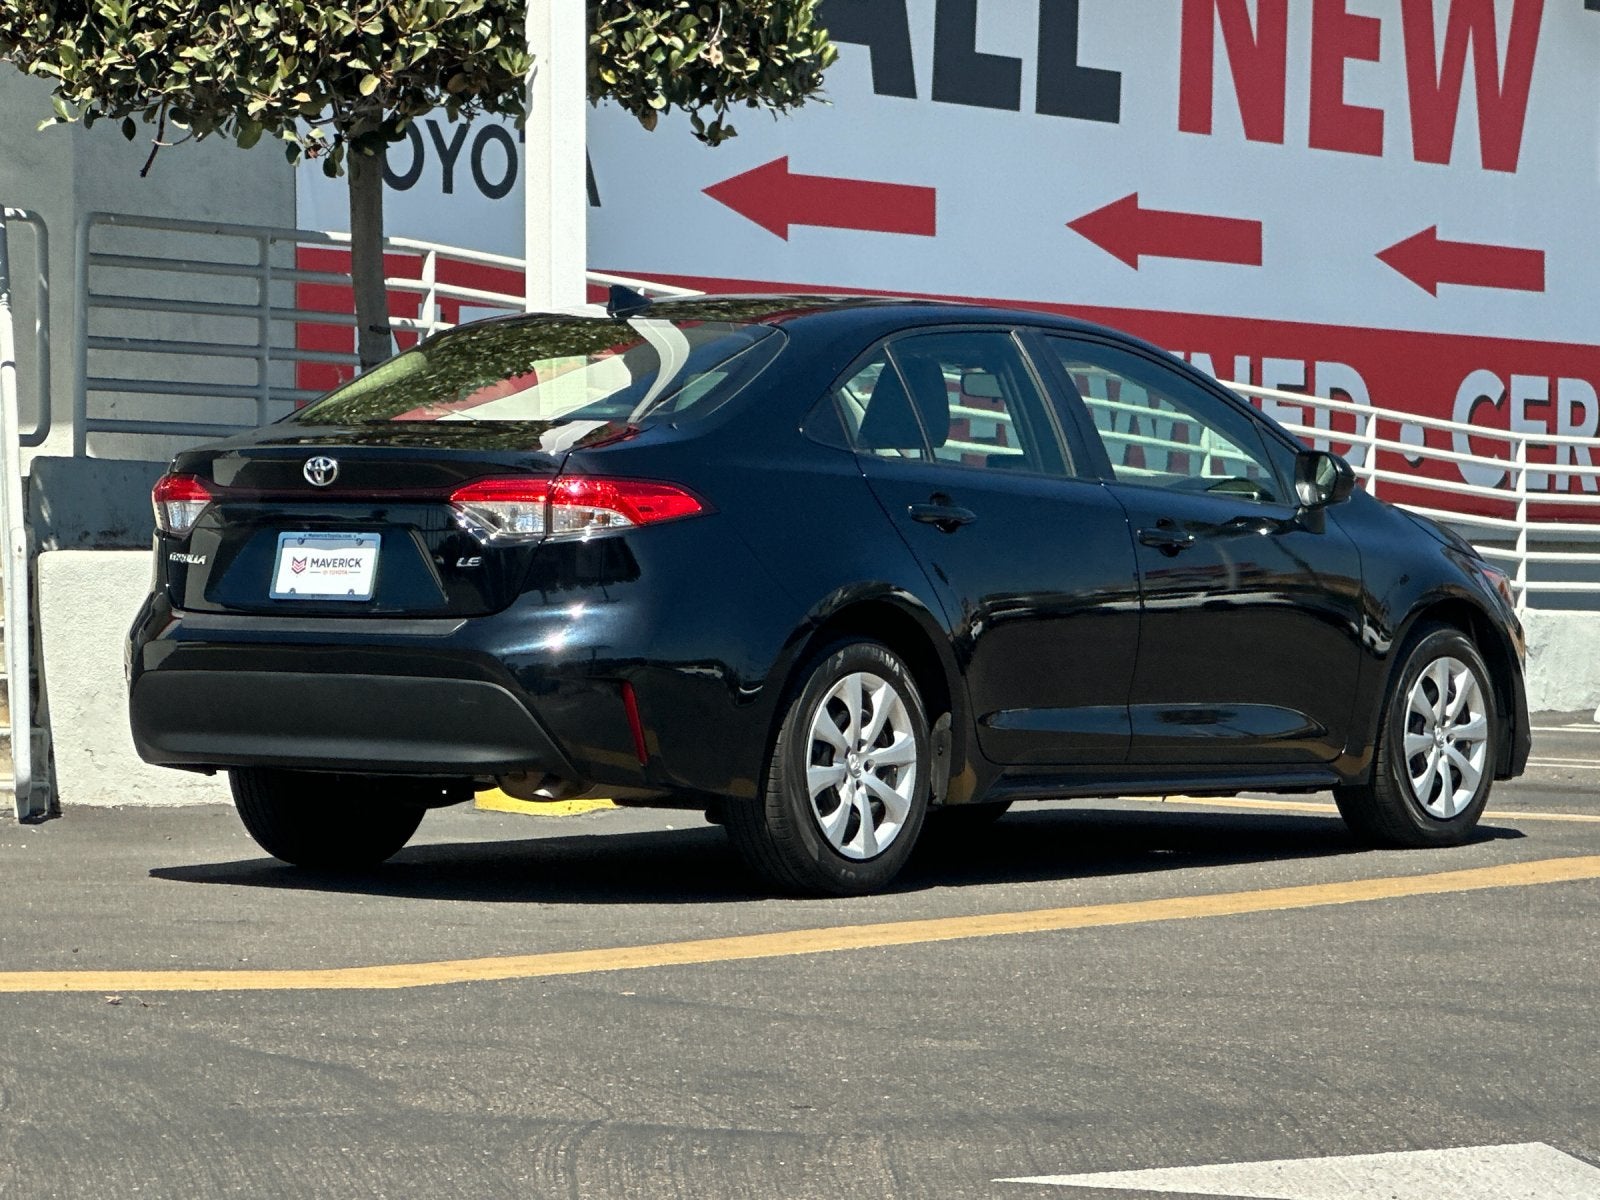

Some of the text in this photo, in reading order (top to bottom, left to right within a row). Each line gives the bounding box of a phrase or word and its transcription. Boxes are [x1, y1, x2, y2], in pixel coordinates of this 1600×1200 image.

[1178, 0, 1544, 174] NEW
[382, 118, 602, 208] OYO
[310, 557, 363, 568] MAVERICK
[456, 556, 481, 567] LE
